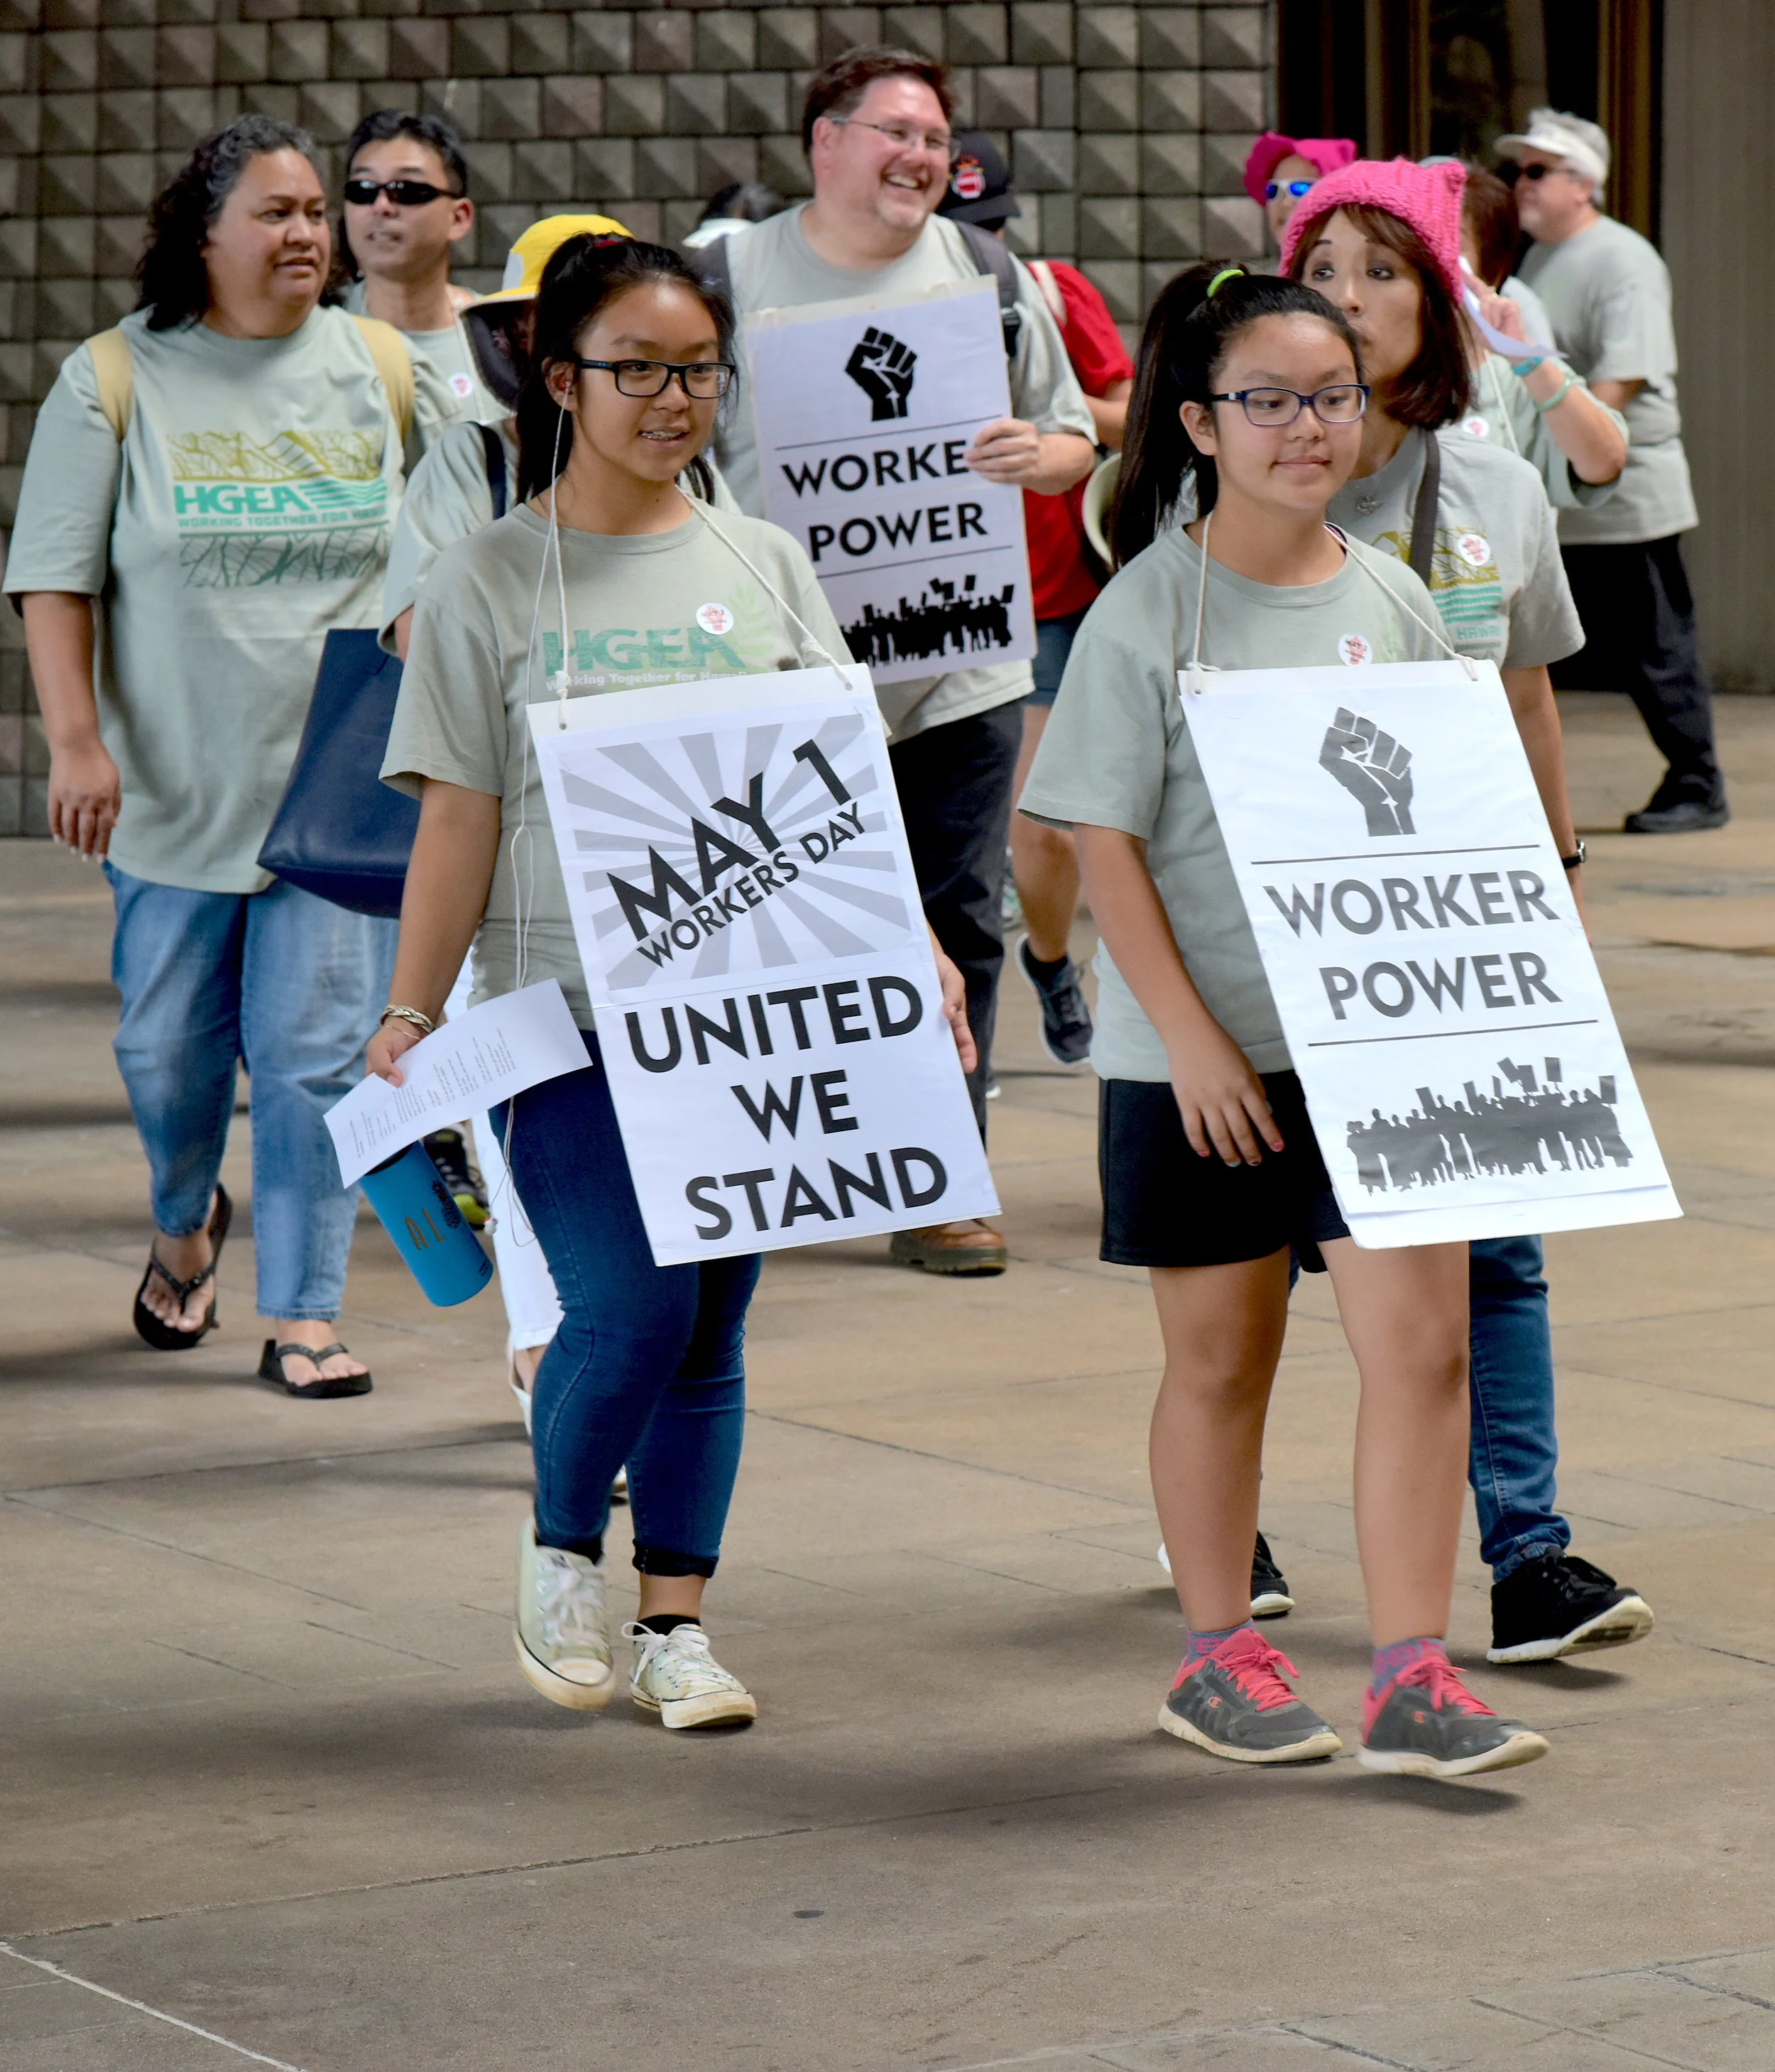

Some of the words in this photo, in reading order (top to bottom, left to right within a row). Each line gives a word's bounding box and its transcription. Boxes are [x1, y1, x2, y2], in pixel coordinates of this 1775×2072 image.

[174, 485, 311, 514] HGEA
[780, 440, 970, 498] WORKE
[178, 516, 242, 527] WORKING
[248, 514, 317, 526] TOGETHER
[808, 502, 988, 562] POWER
[542, 627, 746, 677] HGEA
[609, 672, 670, 685] Together
[675, 671, 695, 682] for
[606, 771, 782, 942] MAY
[792, 738, 851, 805] 1
[637, 851, 799, 969] WORKERS
[799, 801, 865, 863] DAY
[1262, 870, 1561, 939] WORKER
[1319, 952, 1563, 1020] POWER
[624, 975, 924, 1074] UNITED
[730, 1069, 859, 1145] WE
[685, 1147, 948, 1241] STAND
